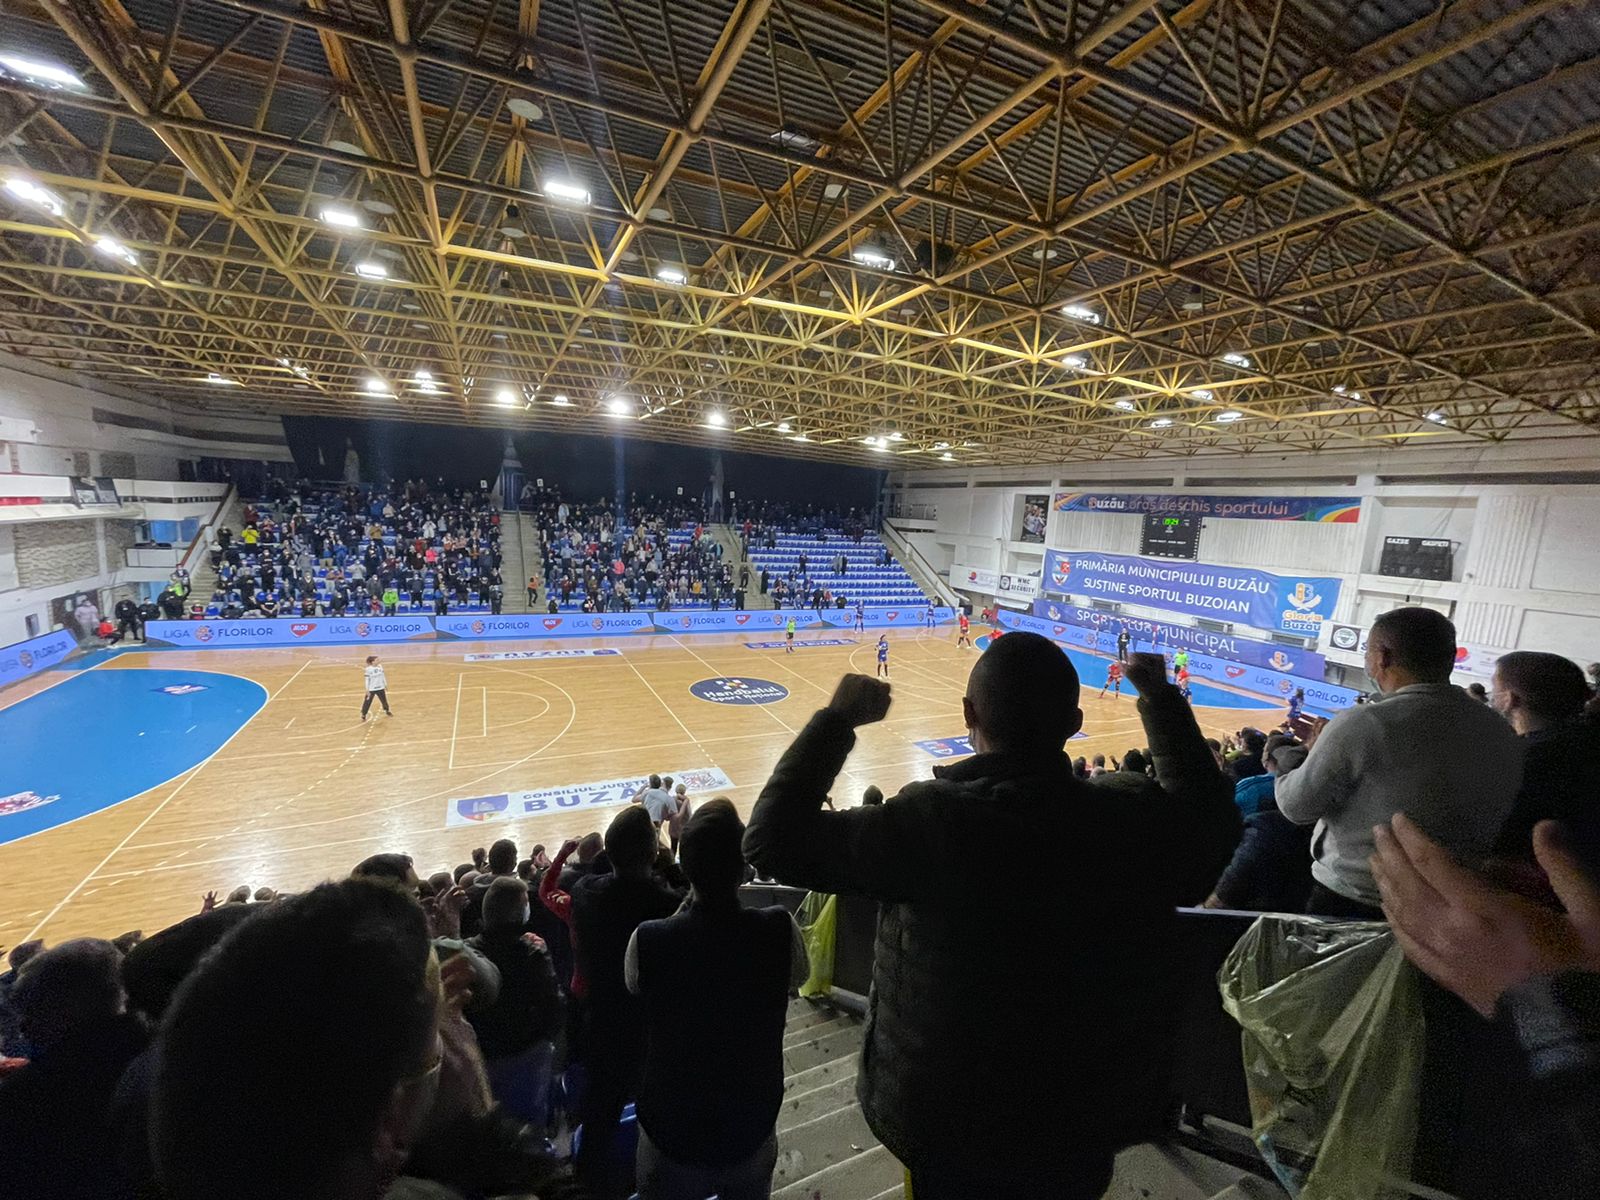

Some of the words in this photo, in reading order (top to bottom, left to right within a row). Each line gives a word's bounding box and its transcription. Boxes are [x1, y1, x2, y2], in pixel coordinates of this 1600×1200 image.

[1215, 501, 1289, 516] sportului
[1076, 559, 1125, 575] PRIMĂRIA
[1128, 565, 1214, 587] MUNICIPIULUI
[1218, 576, 1270, 594] BUZĂU
[1128, 584, 1182, 603] SPORTUL
[1185, 593, 1250, 613] BUZOIAN
[694, 617, 726, 625] FLORILOR
[1284, 610, 1322, 621] Gloria
[449, 623, 468, 631] LIGA
[488, 622, 530, 630] FLORILOR
[606, 619, 642, 627] FLORILOR
[163, 629, 190, 638] LIGA
[218, 627, 273, 637] FLORILOR
[329, 625, 352, 634] LIGA
[374, 624, 421, 633] FLORILOR
[1256, 676, 1275, 687] LIGA
[1300, 687, 1347, 706] LORILOR
[523, 787, 596, 799] CONSILIUL
